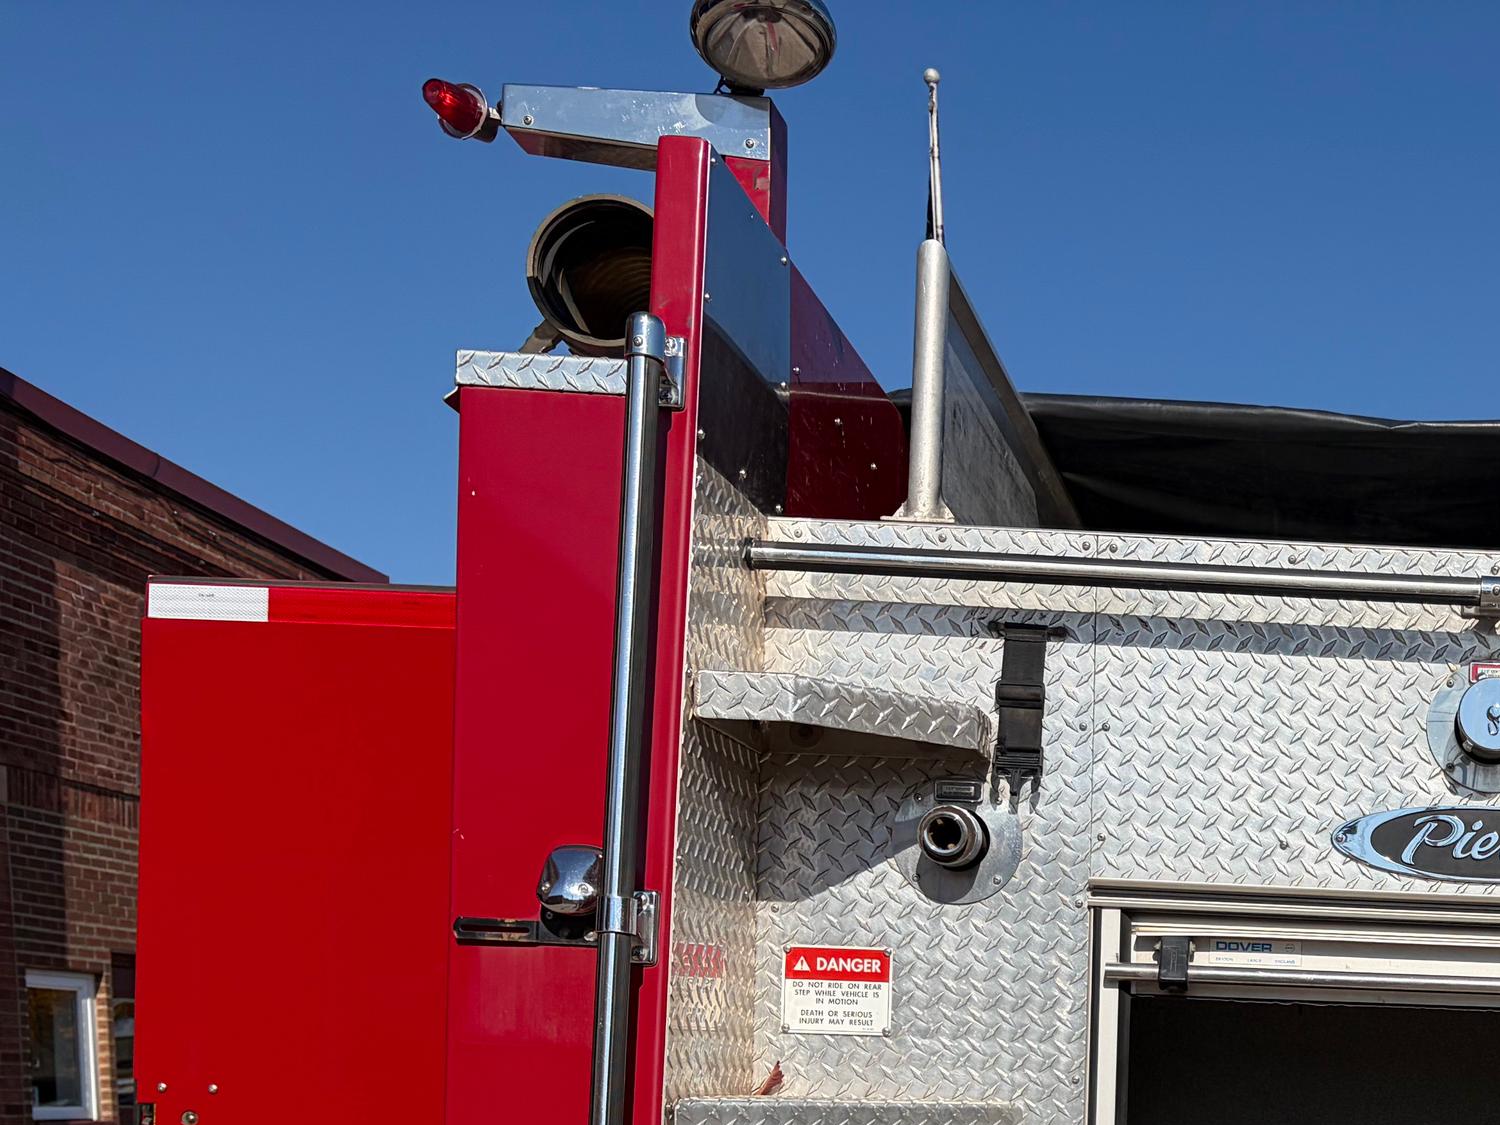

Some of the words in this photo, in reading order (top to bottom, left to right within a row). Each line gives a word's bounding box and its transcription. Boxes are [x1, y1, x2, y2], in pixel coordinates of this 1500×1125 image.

[1216, 941, 1273, 952] DOVER
[816, 957, 881, 973] DANGER
[800, 1009, 824, 1017] DEATH
[843, 1010, 873, 1018] SERIOUS
